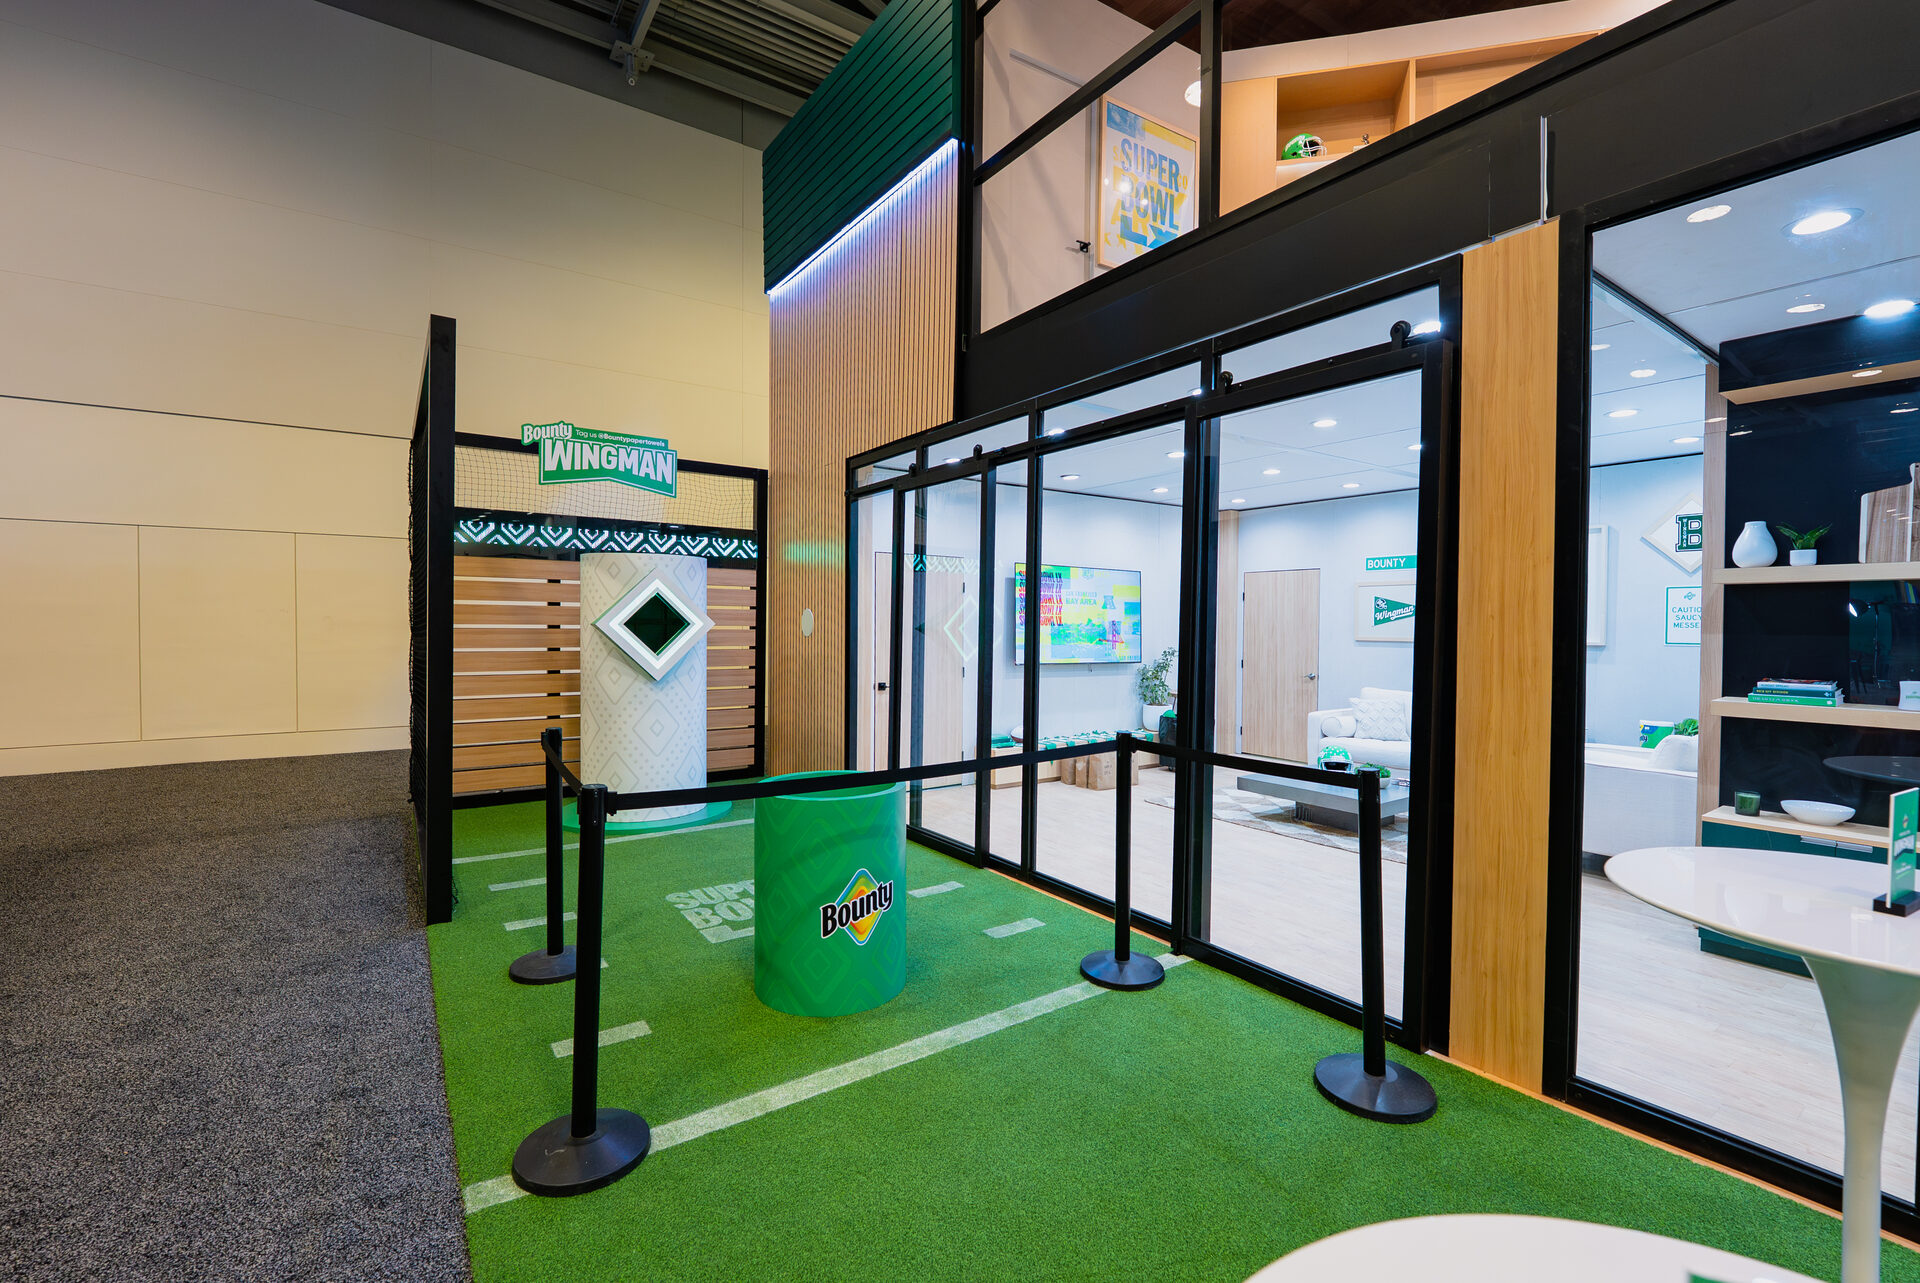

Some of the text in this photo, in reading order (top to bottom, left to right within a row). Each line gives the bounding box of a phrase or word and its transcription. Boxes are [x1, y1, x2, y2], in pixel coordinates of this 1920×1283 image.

[1120, 138, 1180, 193] SUPER
[1121, 174, 1179, 231] BOWL
[523, 422, 572, 443] Bounty
[576, 429, 589, 439] Tag
[598, 433, 665, 447] @Bountypapertowels
[544, 437, 673, 485] WINGMAN
[1367, 558, 1406, 569] BOUNTY
[1375, 605, 1414, 620] Wingman
[665, 880, 754, 909] SUP
[820, 880, 894, 939] Bounty
[681, 898, 754, 930] BO
